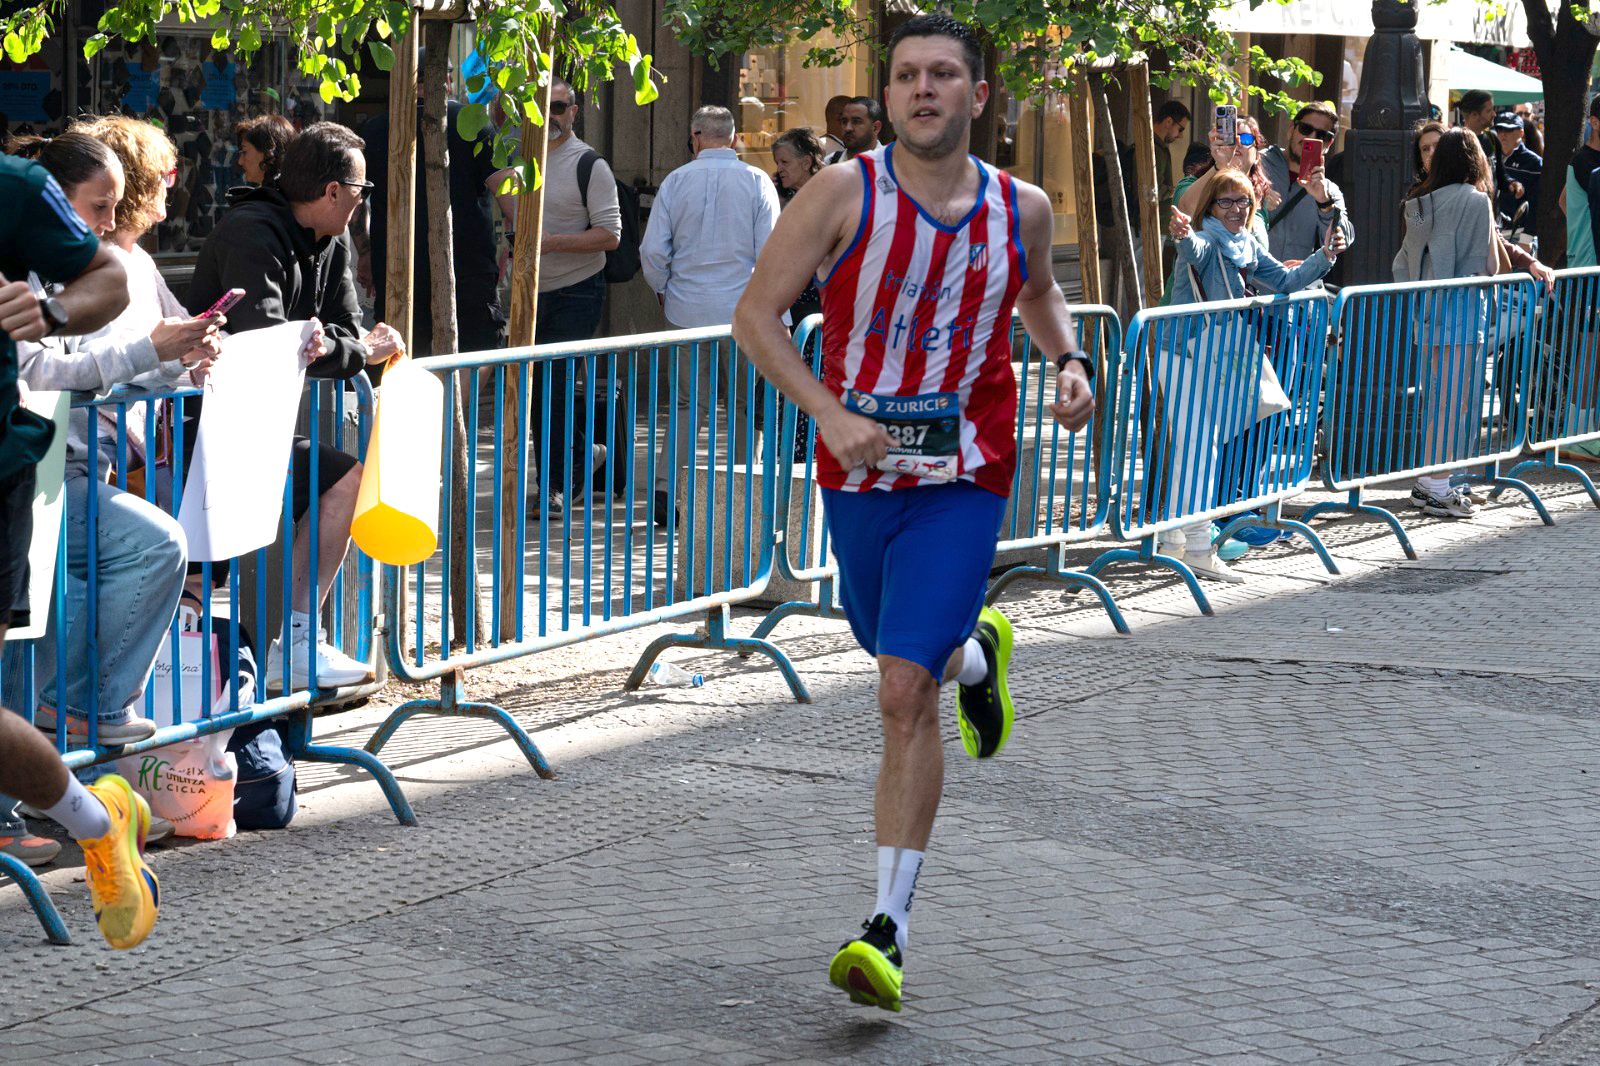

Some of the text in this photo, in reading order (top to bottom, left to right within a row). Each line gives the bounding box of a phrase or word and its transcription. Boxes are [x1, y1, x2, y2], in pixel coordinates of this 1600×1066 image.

[864, 307, 974, 352] Atleti
[138, 755, 170, 791] RE
[166, 772, 206, 786] UTILITZA
[166, 783, 206, 794] CICLA
